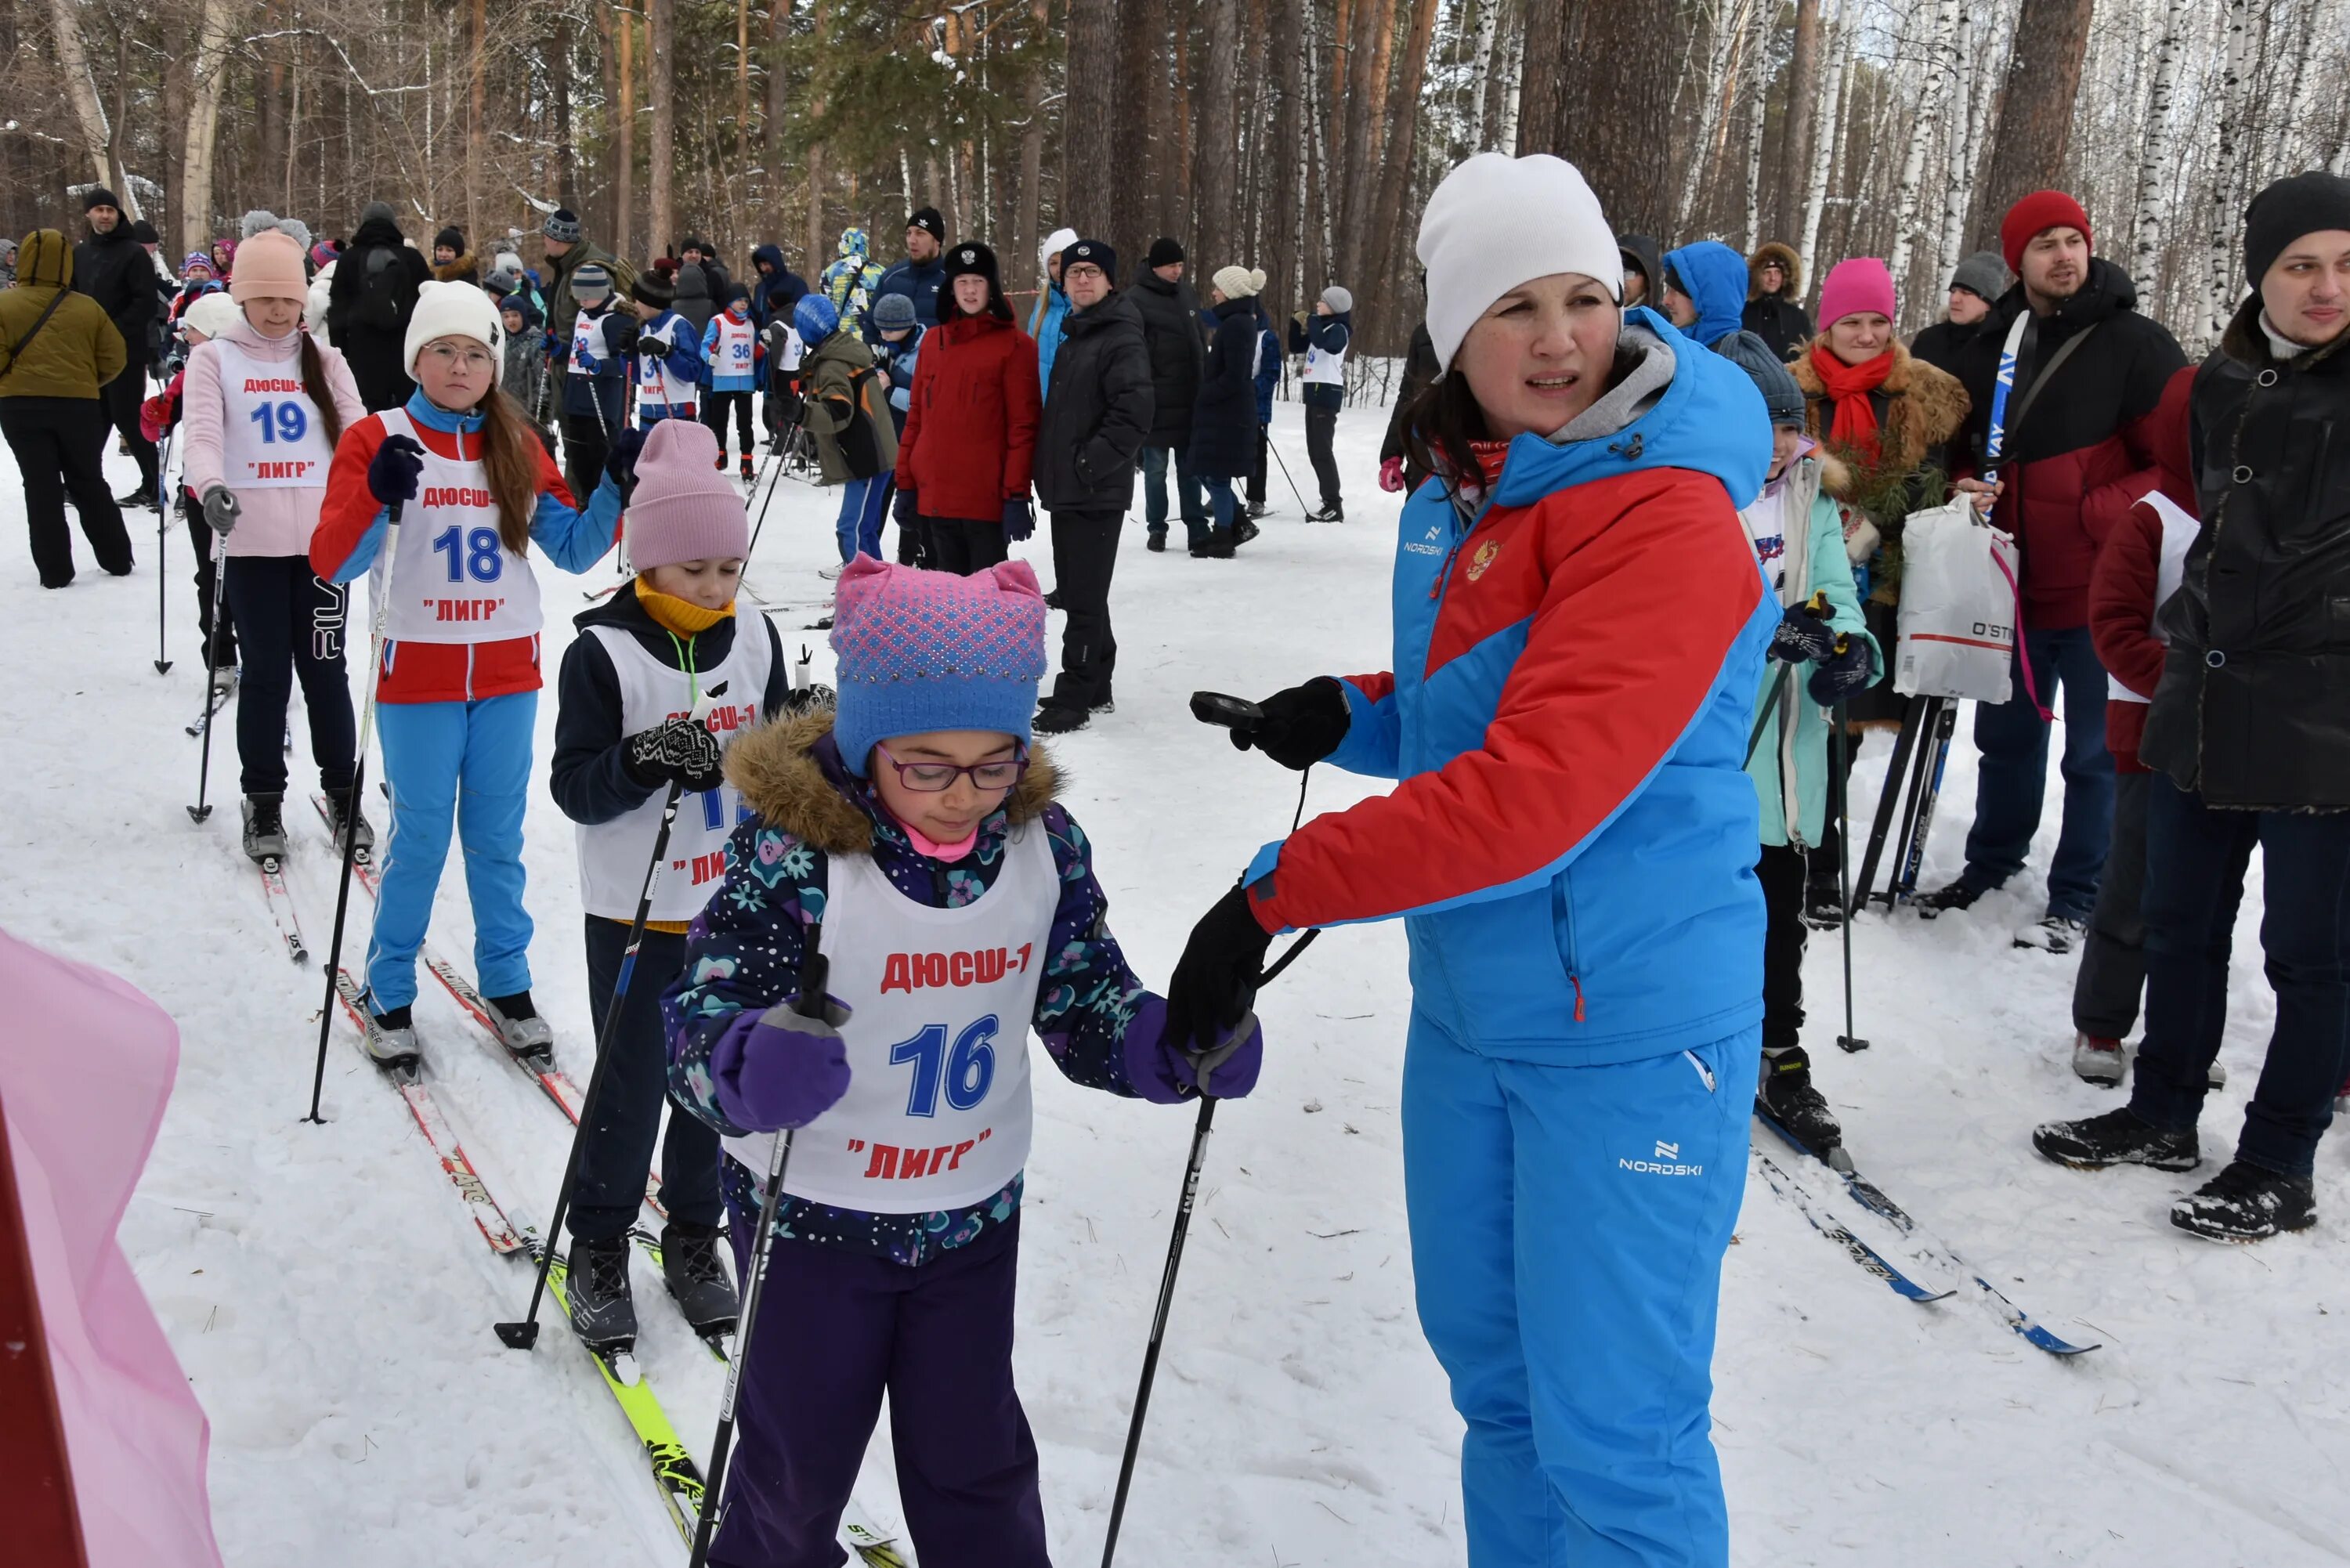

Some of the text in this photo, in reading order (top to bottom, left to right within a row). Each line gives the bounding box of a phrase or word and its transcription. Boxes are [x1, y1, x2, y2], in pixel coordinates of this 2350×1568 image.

[732, 344, 750, 359] 36
[251, 400, 307, 443] 19
[248, 461, 315, 479] "ЛИГР"
[423, 487, 497, 508] ДЮСШ-
[433, 525, 503, 583] 18
[1404, 542, 1444, 556] NORDSKI
[423, 598, 504, 621] "ЛИГР"
[667, 704, 755, 733] СШ-1
[673, 851, 726, 886] "ЛИ
[880, 942, 1032, 995] ДЮСШ-1
[364, 1014, 383, 1045] ISCHER
[516, 1058, 542, 1086] ATOMIC
[889, 1013, 999, 1118] 16
[847, 1128, 992, 1180] "ЛИГР"
[1619, 1158, 1702, 1176] NORDSKI
